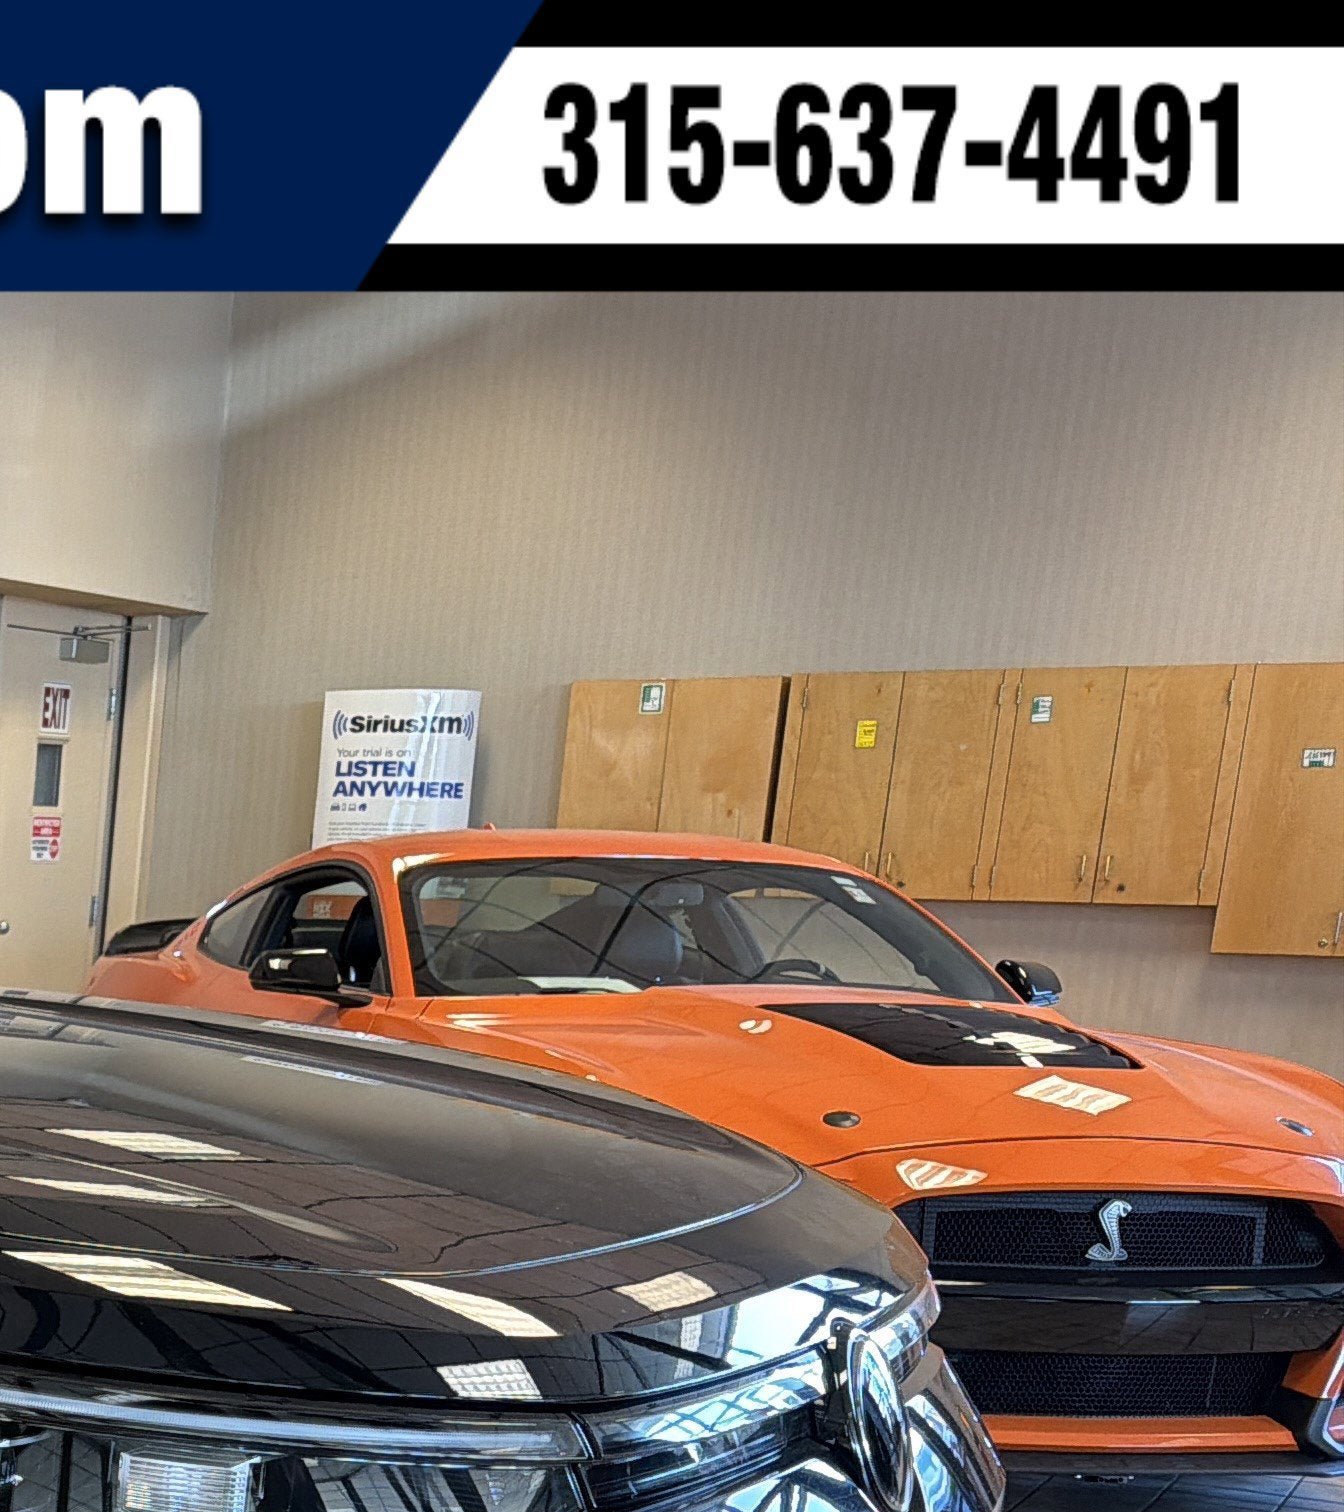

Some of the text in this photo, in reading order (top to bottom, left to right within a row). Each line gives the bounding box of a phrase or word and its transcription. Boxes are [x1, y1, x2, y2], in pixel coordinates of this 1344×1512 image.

[42, 686, 71, 730] EXIT
[337, 748, 360, 758] Your
[362, 747, 382, 757] trial
[384, 748, 394, 758] is
[335, 761, 416, 778] LISTEN
[332, 780, 465, 799] ANYWHERE
